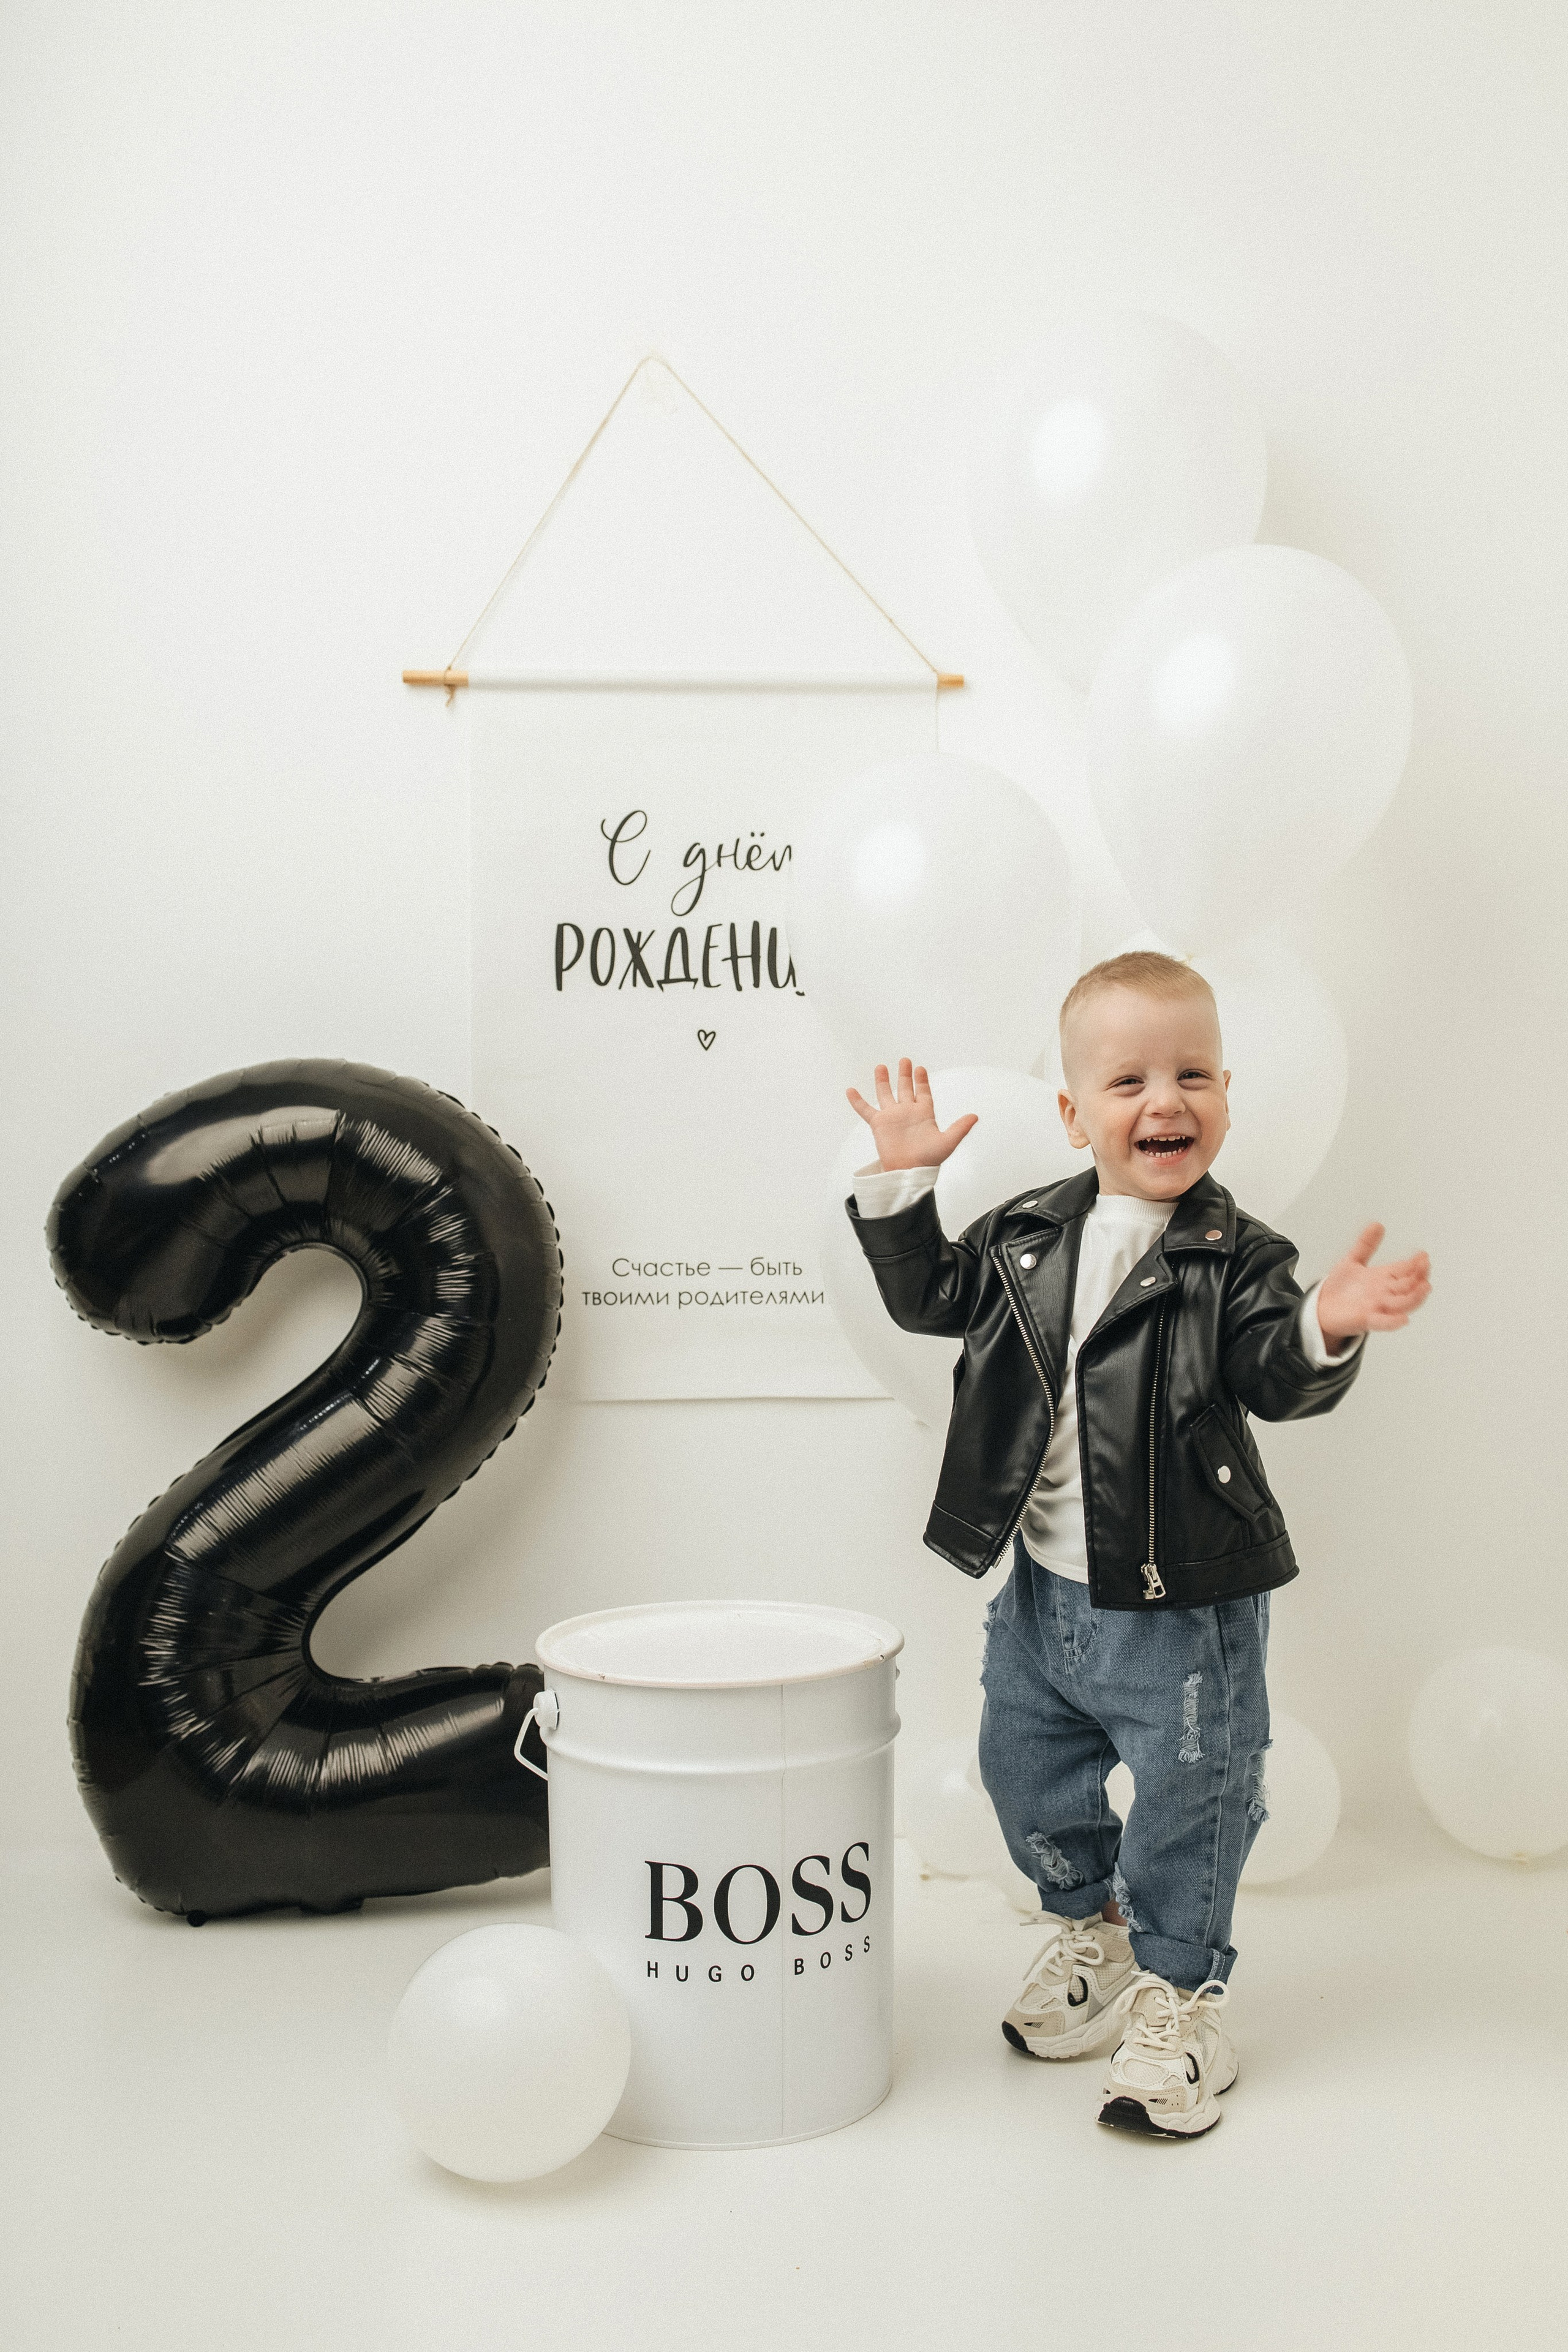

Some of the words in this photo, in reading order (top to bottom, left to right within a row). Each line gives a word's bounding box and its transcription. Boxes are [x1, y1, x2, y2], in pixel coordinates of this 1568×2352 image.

[600, 810, 651, 886] С
[555, 920, 805, 997] РОЖДЕНИ
[612, 1257, 710, 1277] Счастье
[750, 1257, 802, 1276] быть
[581, 1291, 669, 1306] твоими
[678, 1291, 824, 1310] родителями
[644, 1841, 872, 1945] BOSS
[646, 1960, 755, 1983] HUGO
[794, 1935, 871, 1976] BOSS
